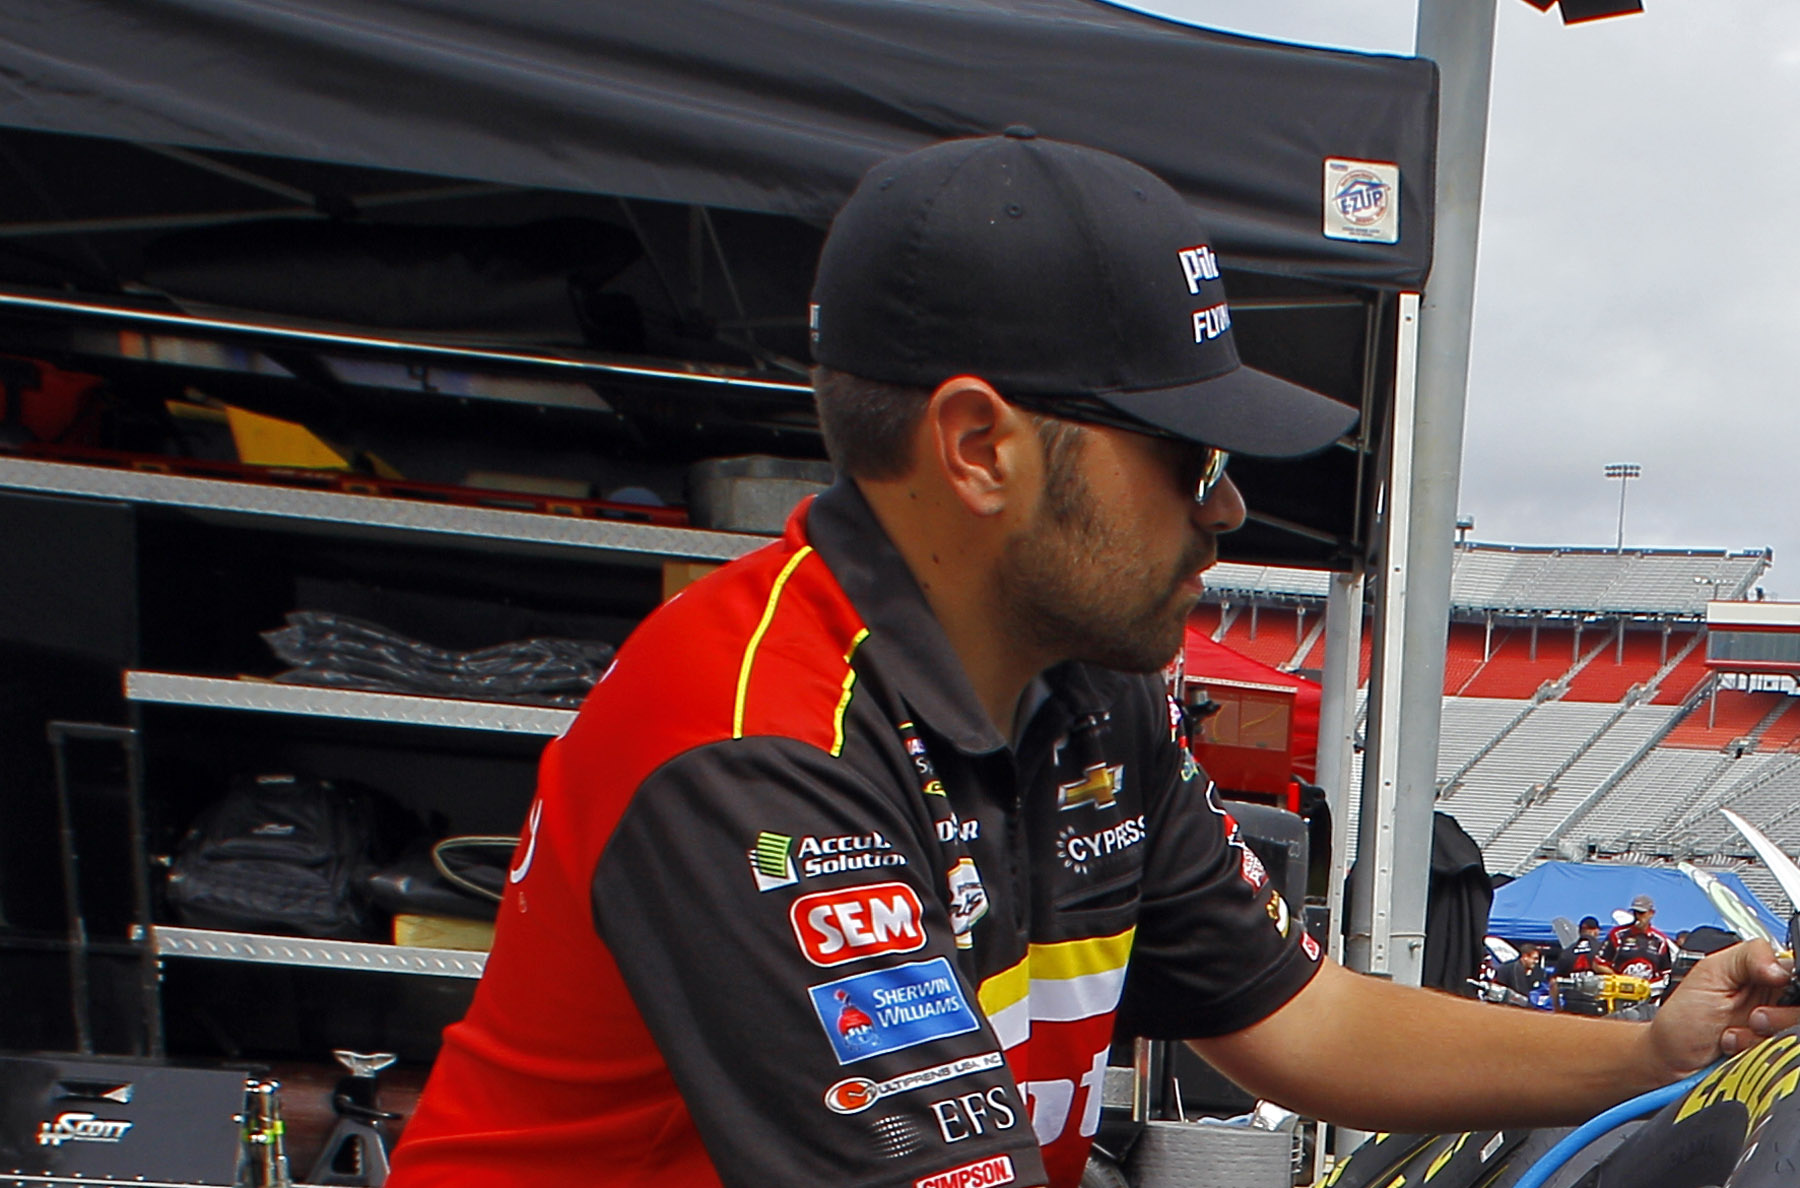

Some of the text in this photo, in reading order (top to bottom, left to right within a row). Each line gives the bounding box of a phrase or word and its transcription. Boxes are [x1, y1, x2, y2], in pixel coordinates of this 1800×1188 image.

[808, 895, 918, 955] SEM
[873, 977, 951, 1009] SHERWIN
[876, 995, 961, 1028] WILLIAMS
[929, 1087, 1016, 1143] EFS
